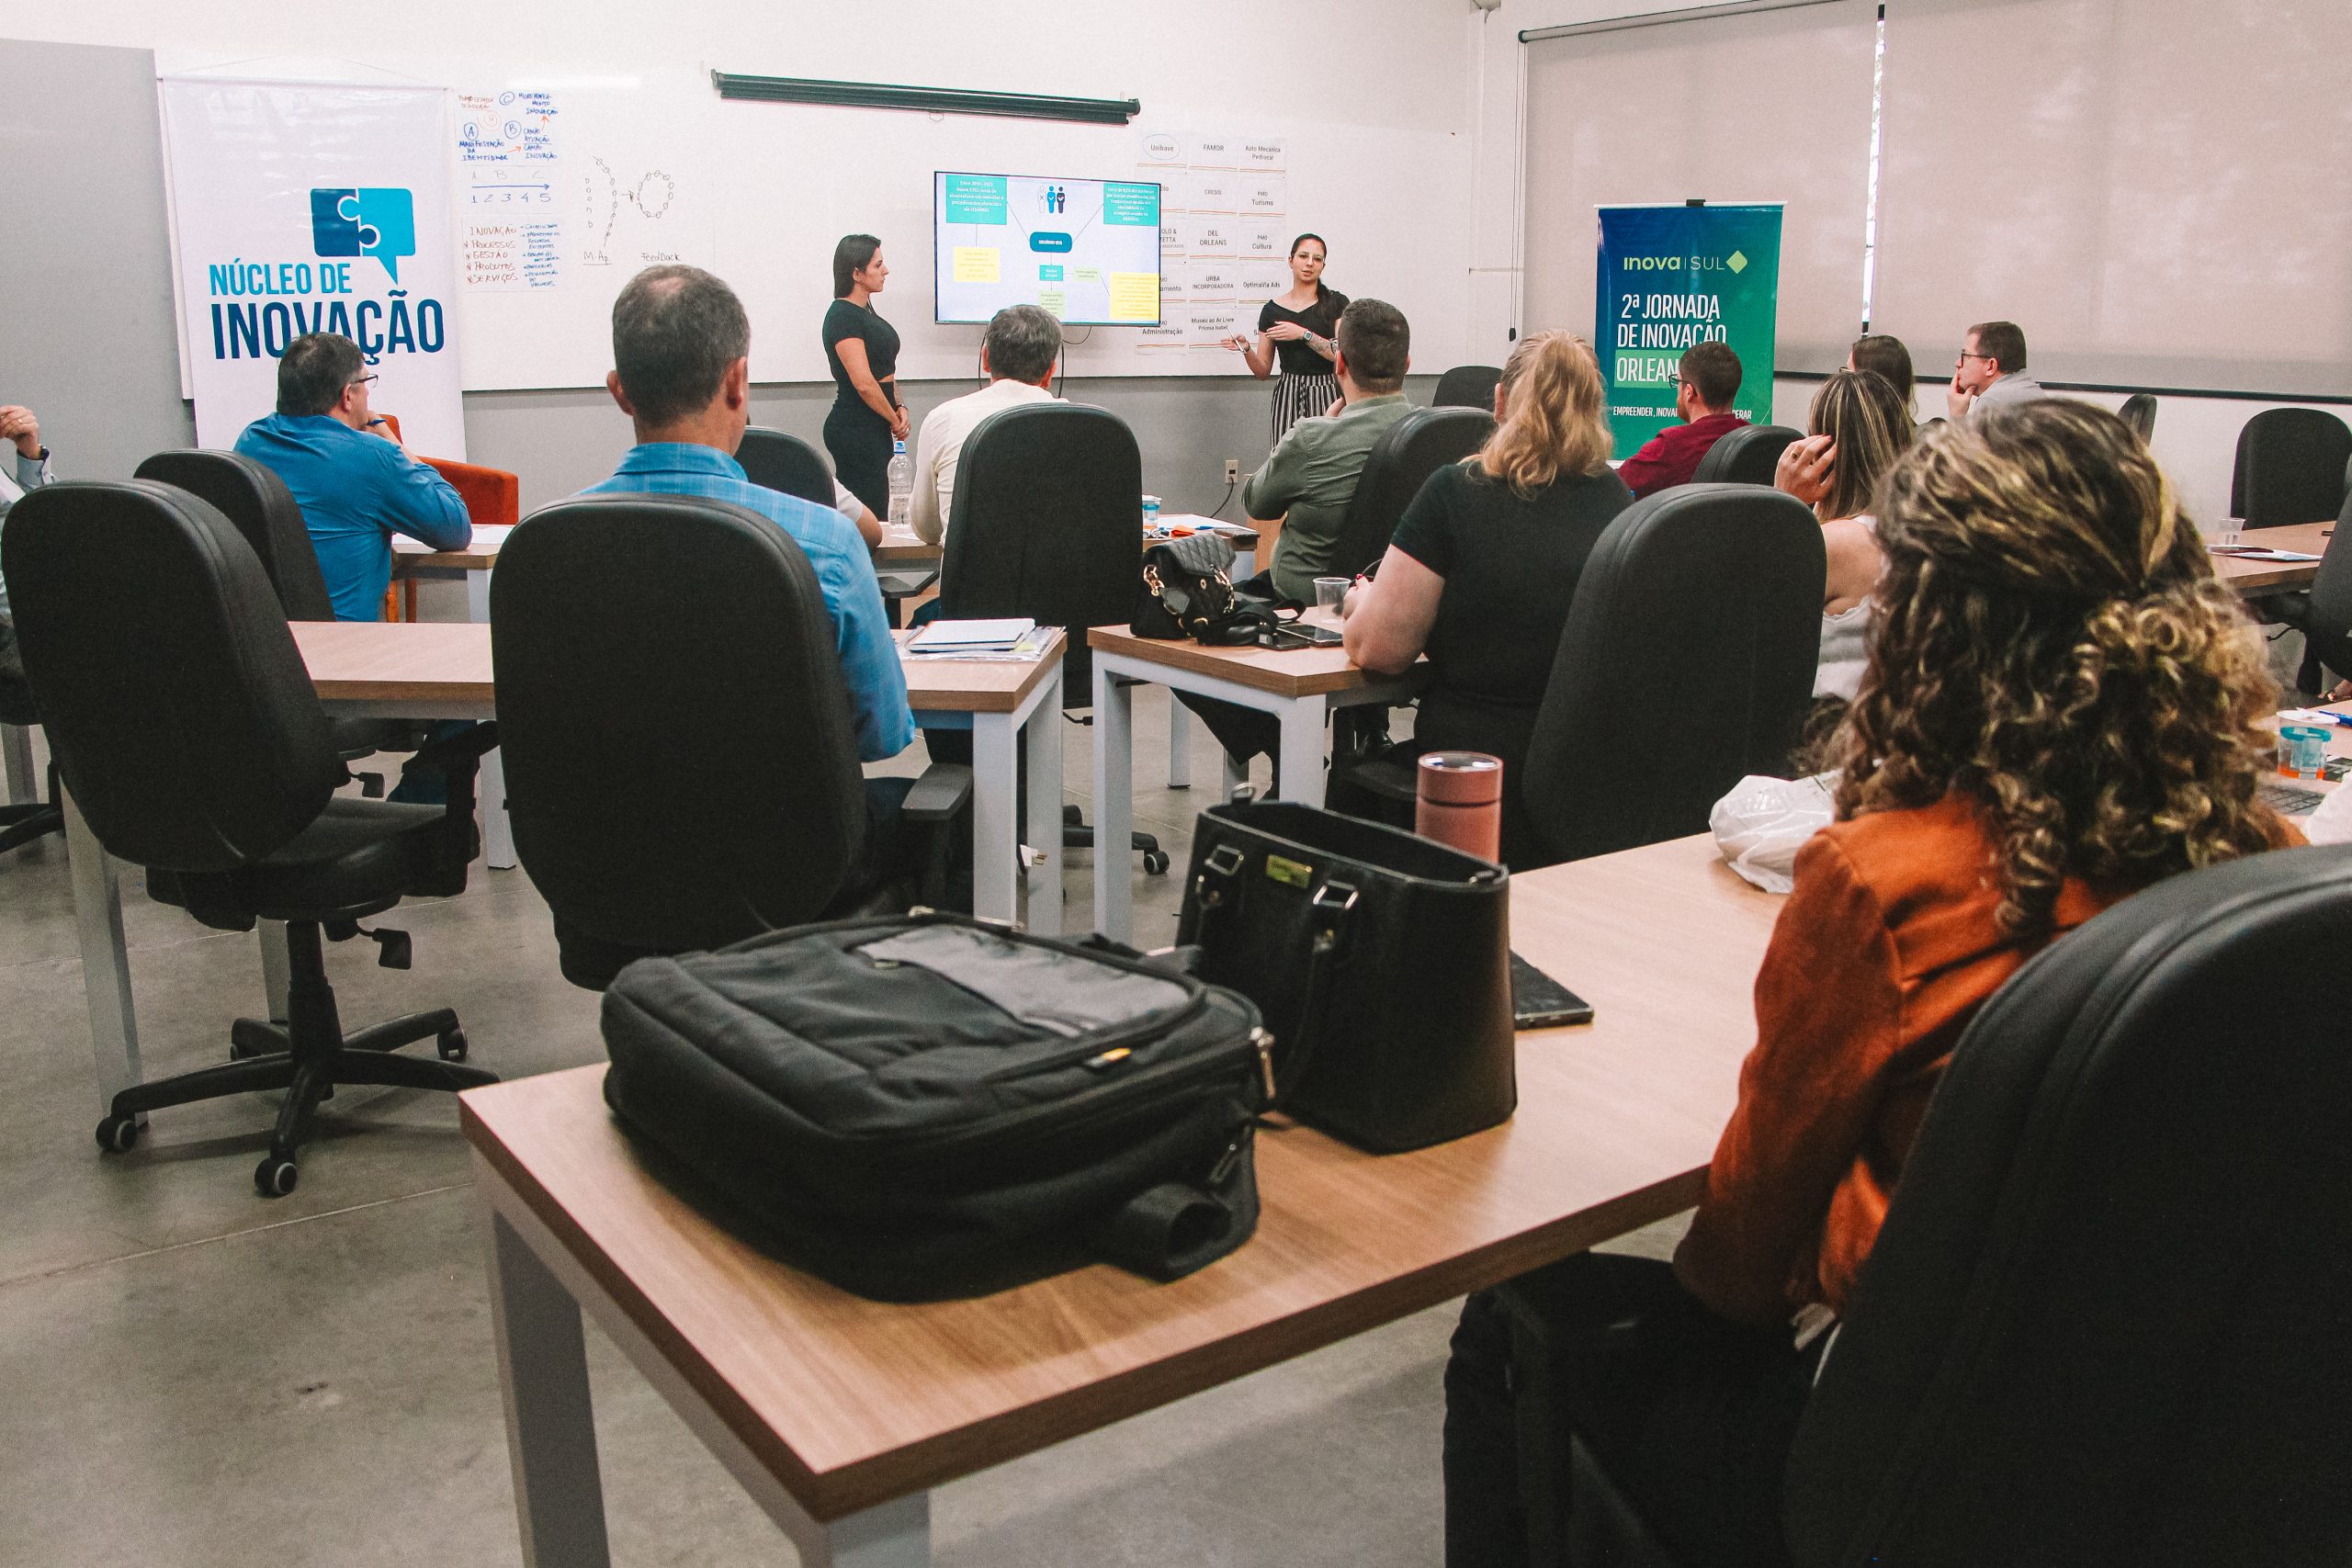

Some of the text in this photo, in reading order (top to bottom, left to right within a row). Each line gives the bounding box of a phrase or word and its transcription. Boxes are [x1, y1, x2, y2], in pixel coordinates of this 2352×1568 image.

[468, 126, 475, 137] A
[509, 123, 517, 135] B
[1150, 143, 1174, 152] Unibave
[1203, 144, 1225, 152] FAMOR
[483, 194, 493, 203] 2
[500, 193, 512, 202] 3
[521, 192, 529, 203] 4
[539, 193, 551, 202] 5
[1251, 198, 1274, 207] Turismo
[471, 239, 516, 250] PROCESSOS
[472, 250, 508, 258] GESTÃO
[475, 261, 515, 271] PRODUTOS
[1690, 256, 1725, 271] SUL
[209, 257, 353, 296] NÚCLEO DE
[472, 273, 518, 284] SERVIÇOS
[1642, 294, 1720, 320] JORNADA
[1142, 328, 1183, 336] Administração
[1617, 323, 1638, 348] DE
[1616, 356, 1680, 382] ORLEAN
[1656, 407, 1678, 417] INOVA
